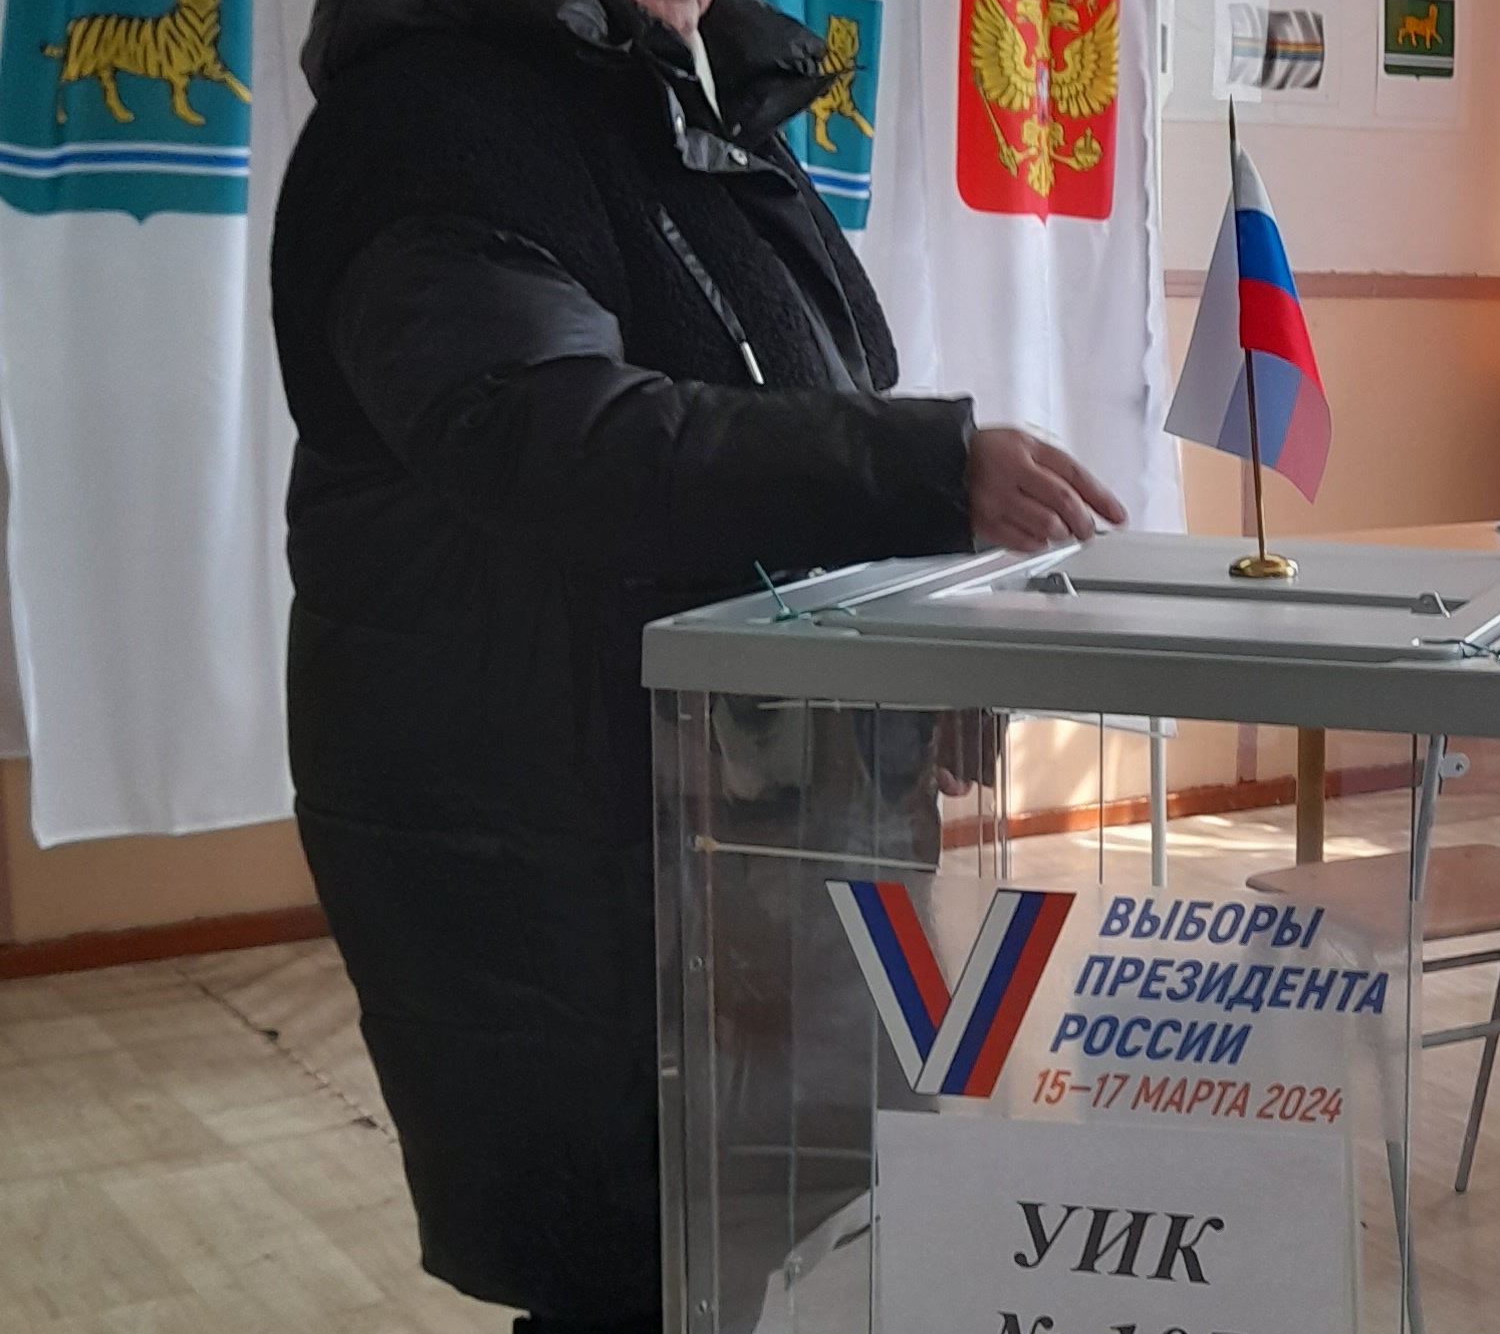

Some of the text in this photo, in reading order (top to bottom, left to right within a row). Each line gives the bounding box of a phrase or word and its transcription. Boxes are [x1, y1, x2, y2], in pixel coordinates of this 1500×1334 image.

[1098, 895, 1326, 950] ВЫБОРЫ
[1074, 953, 1390, 1015] ПРЕЗИДЕНТА
[1049, 1012, 1253, 1065] РОССИИ
[1131, 1074, 1252, 1119] МАРТА
[1255, 1082, 1345, 1125] 2024
[1013, 1199, 1226, 1286] УИК
